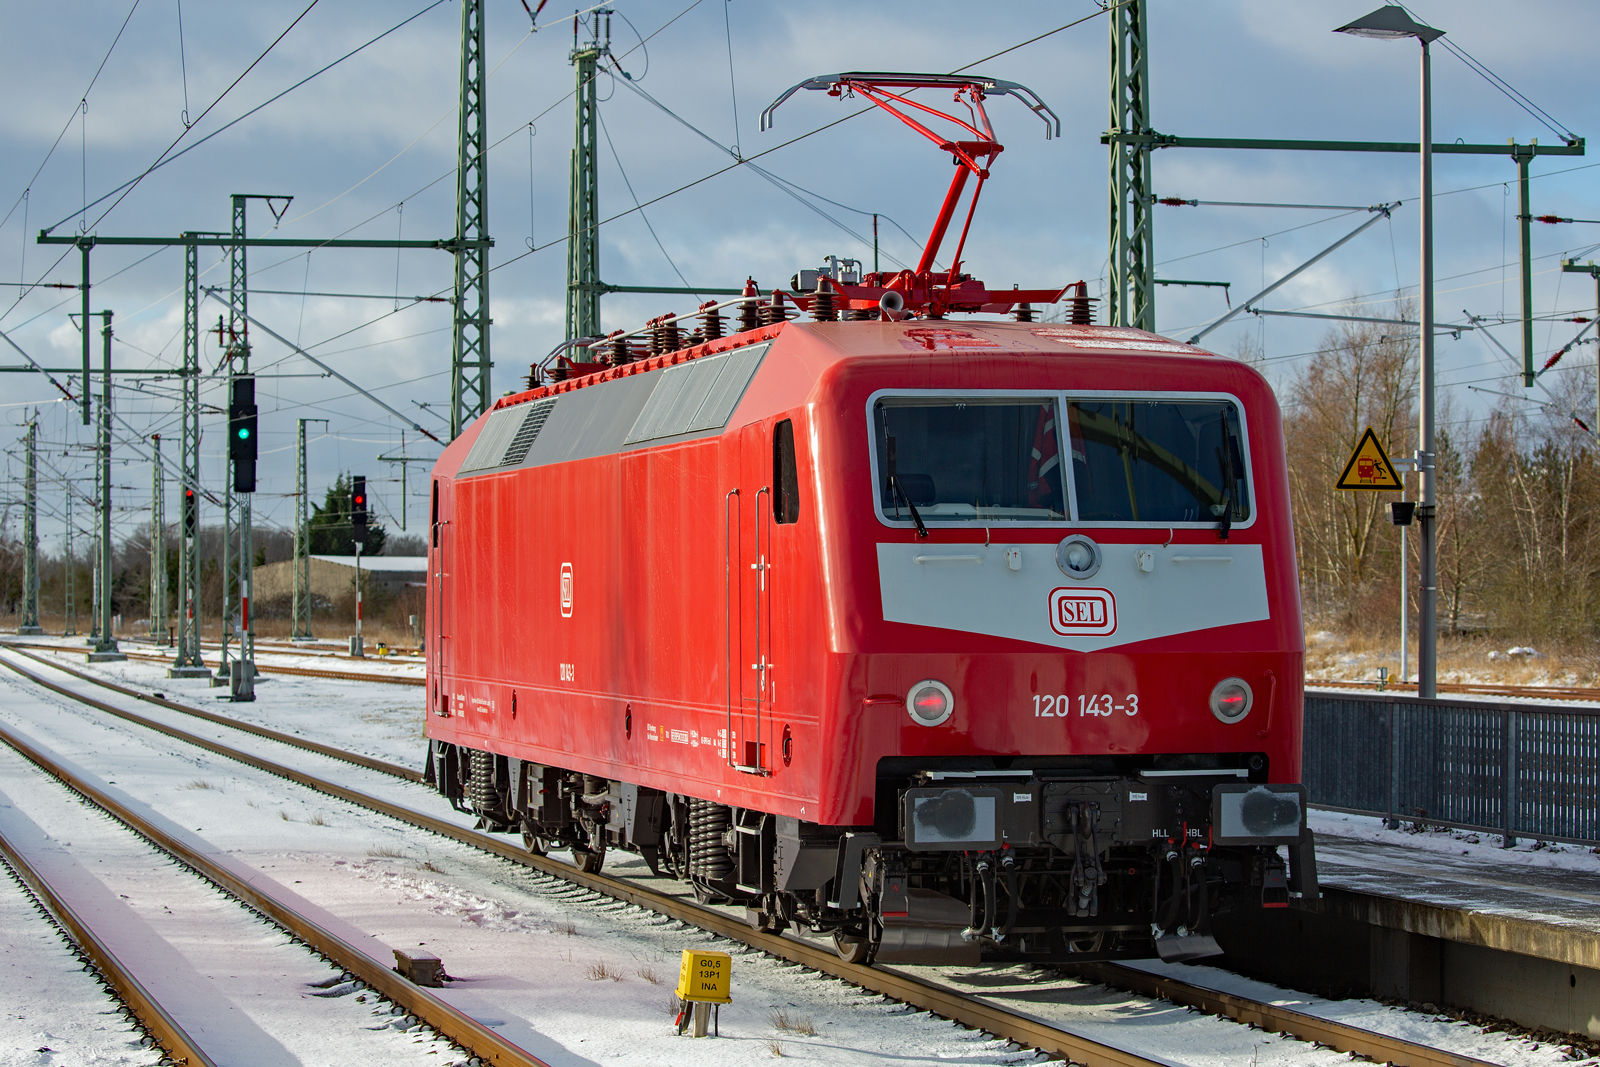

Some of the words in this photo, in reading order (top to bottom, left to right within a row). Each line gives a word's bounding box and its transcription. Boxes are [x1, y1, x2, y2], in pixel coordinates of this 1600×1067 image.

[1063, 601, 1102, 622] SEL
[1032, 694, 1069, 717] 120
[1078, 693, 1139, 717] 143-3
[1152, 829, 1169, 838] HLL
[1186, 828, 1203, 837] HBL
[700, 959, 721, 969] G0,5
[699, 970, 720, 979] 13P1
[701, 982, 718, 991] INA
